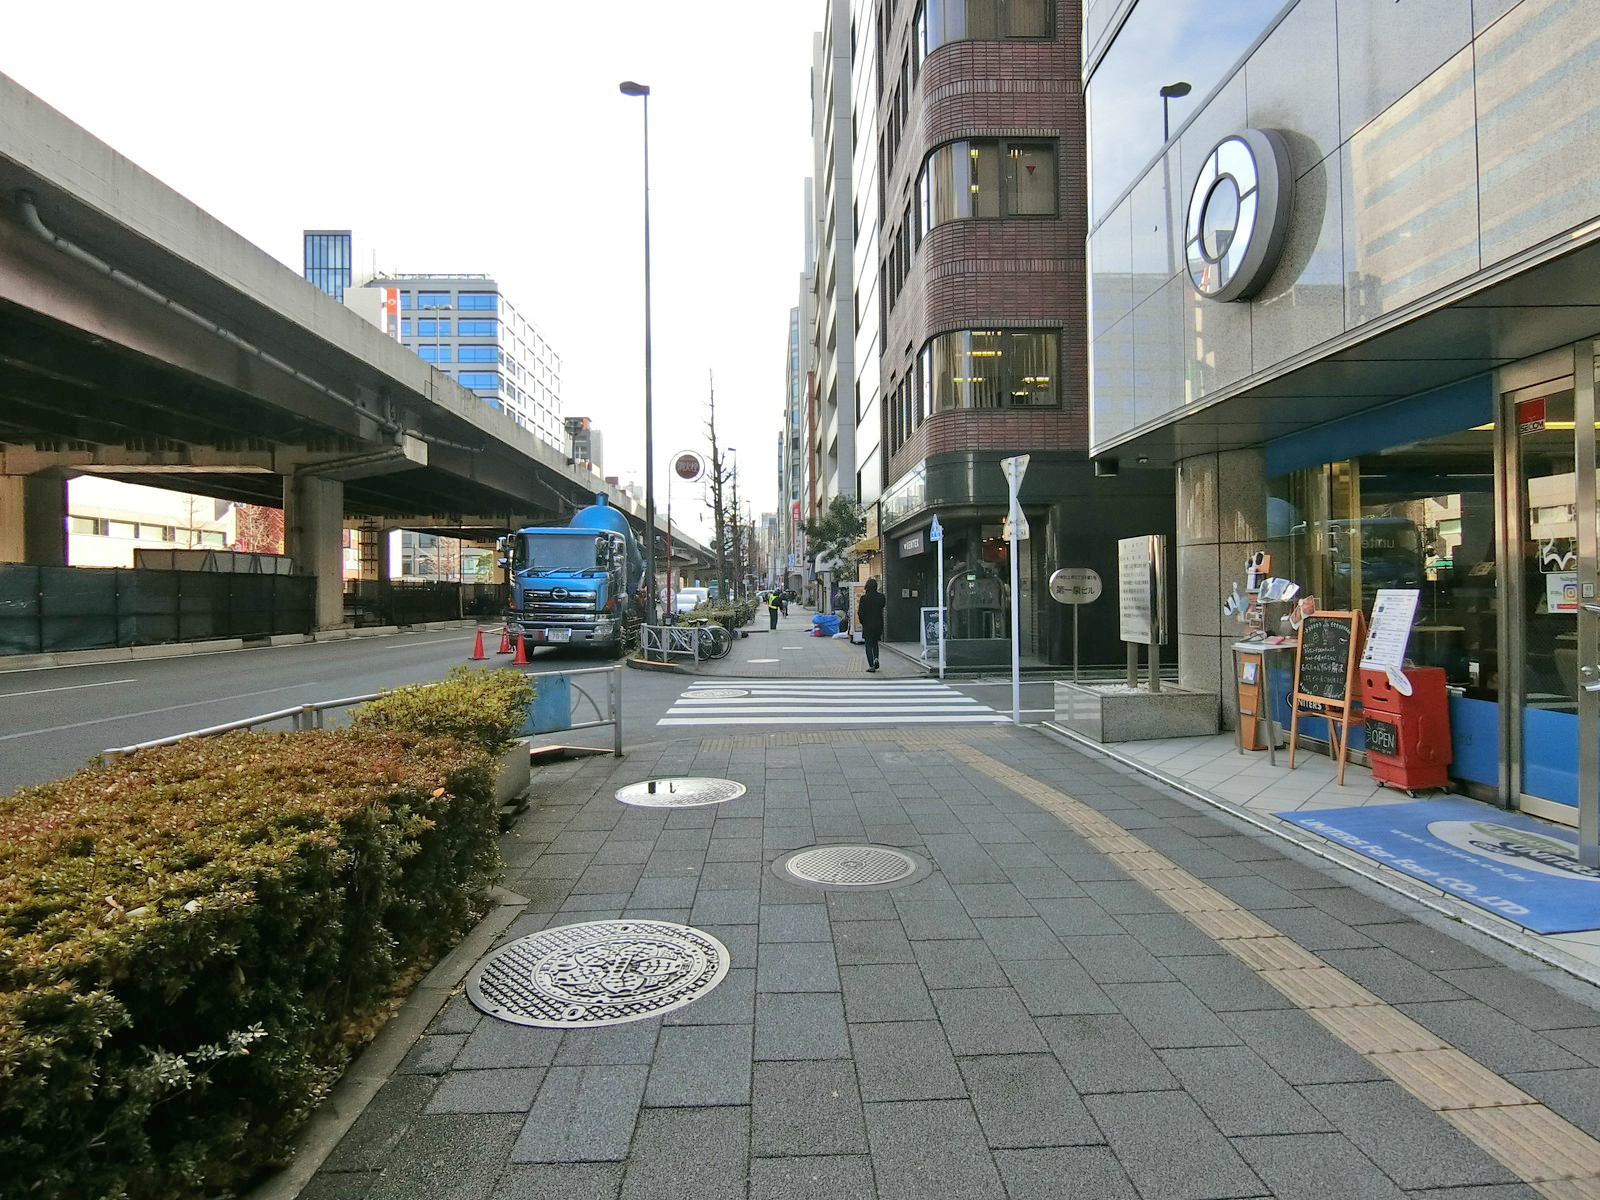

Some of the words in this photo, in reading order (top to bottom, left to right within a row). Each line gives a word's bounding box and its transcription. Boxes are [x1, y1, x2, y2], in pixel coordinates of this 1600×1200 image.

[1520, 420, 1544, 432] SECOM
[677, 461, 699, 472] 消火栓
[1297, 698, 1322, 710] NITERS
[1371, 729, 1395, 749] OPEN
[1299, 818, 1370, 846] UNITERS
[1360, 844, 1396, 859] Far
[1390, 858, 1440, 876] East
[1506, 843, 1600, 878] UNITERS
